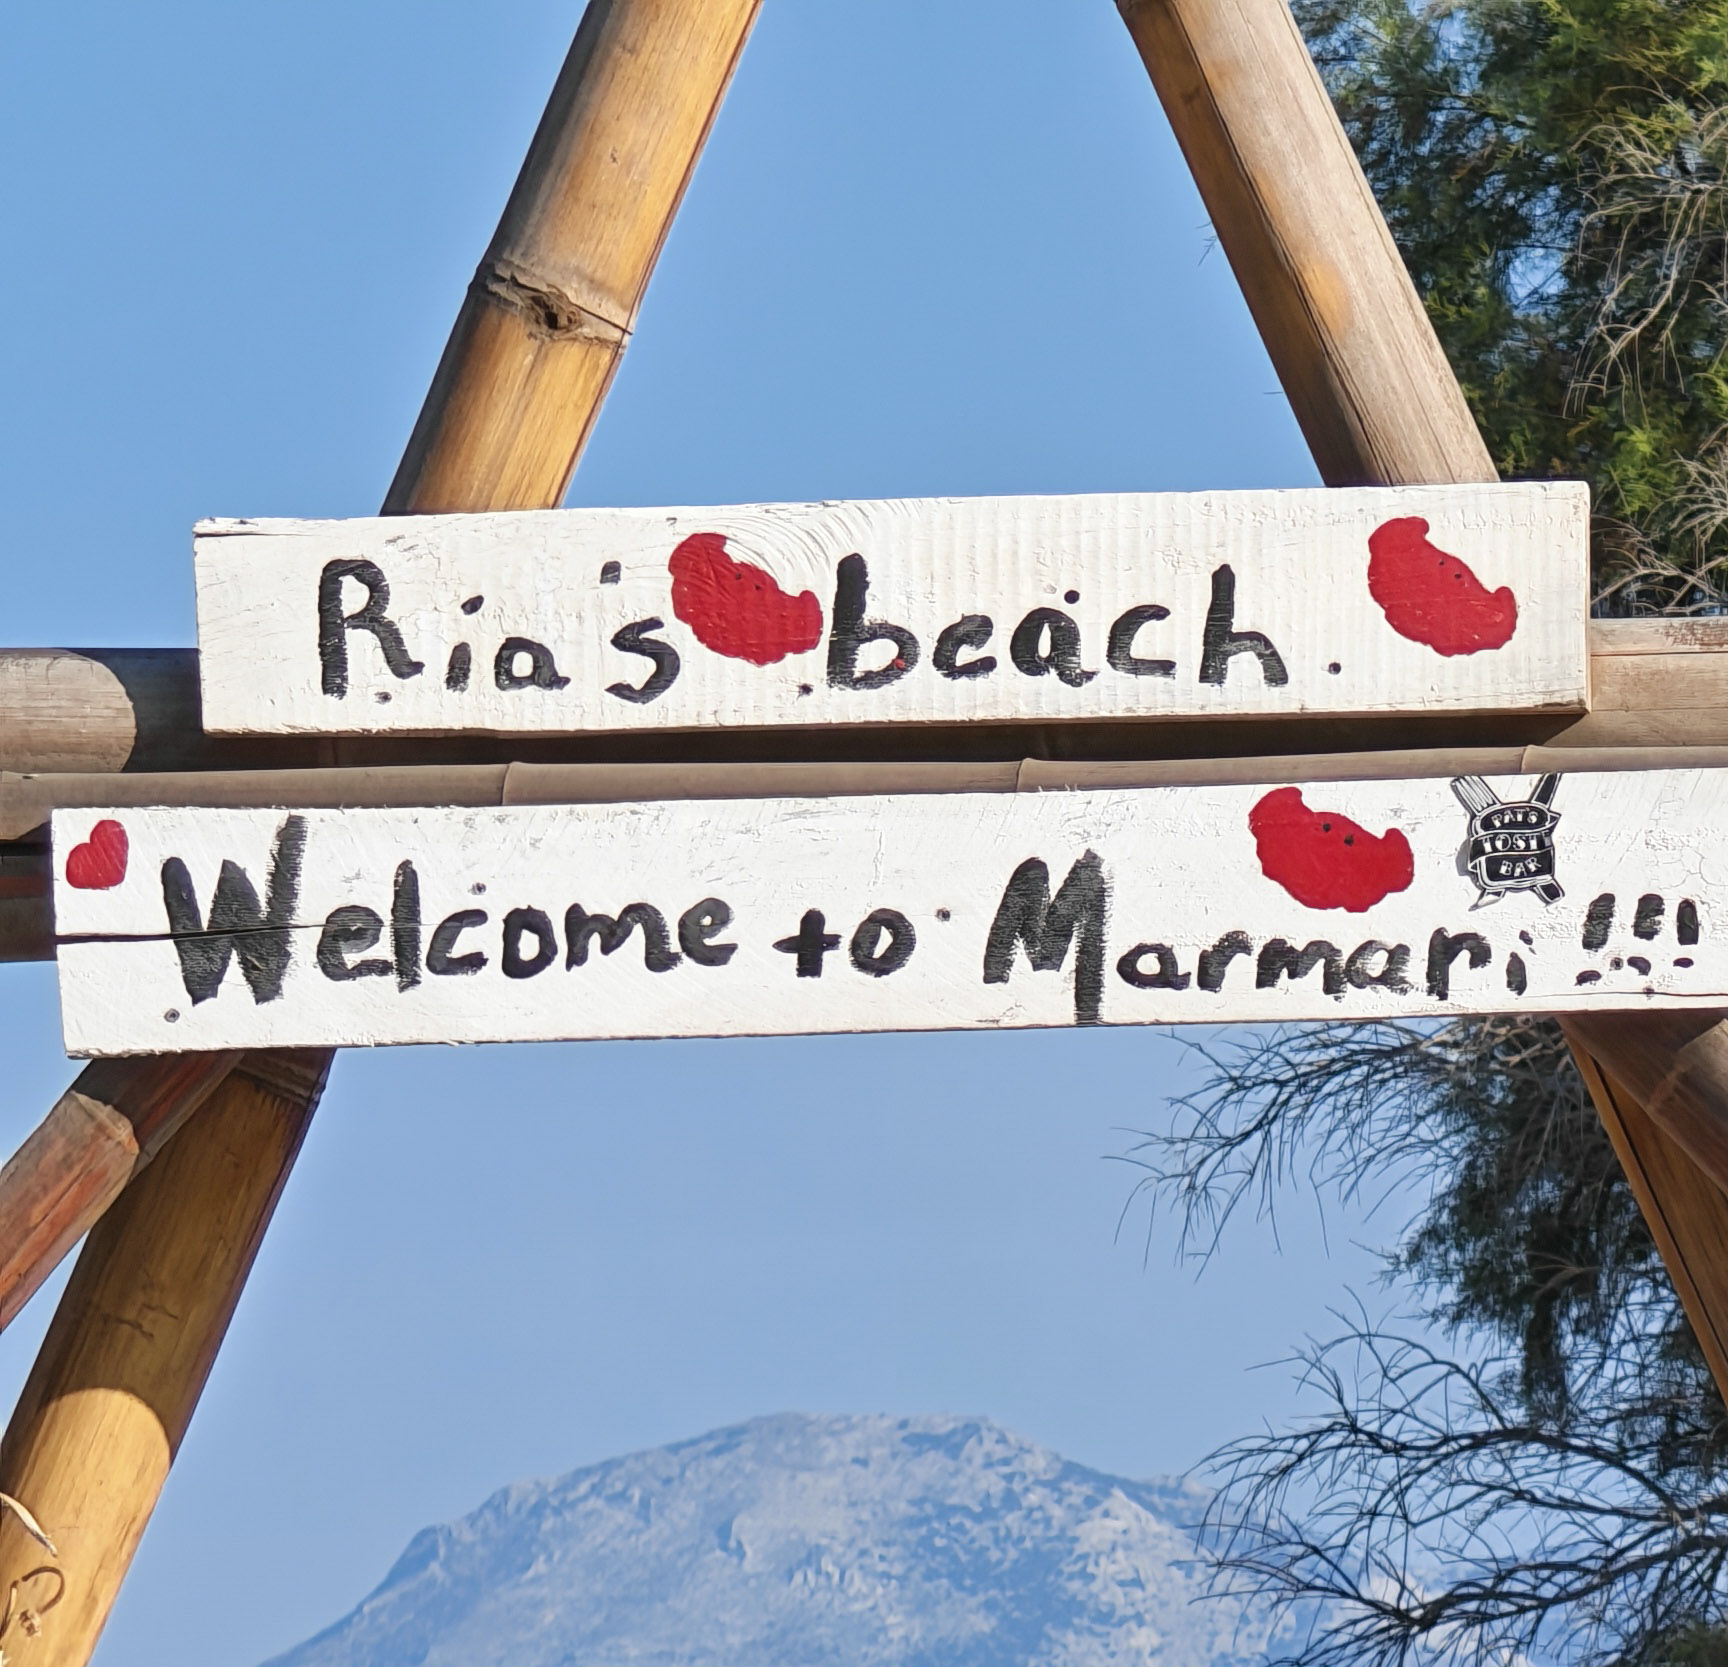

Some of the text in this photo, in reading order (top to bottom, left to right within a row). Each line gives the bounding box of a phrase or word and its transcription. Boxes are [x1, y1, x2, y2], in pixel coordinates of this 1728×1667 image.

[317, 552, 1290, 704] Ria's beach
[1491, 808, 1539, 828] PAT'S
[1499, 857, 1542, 877] BAR
[160, 814, 739, 1008] Welcome
[771, 907, 919, 979] to
